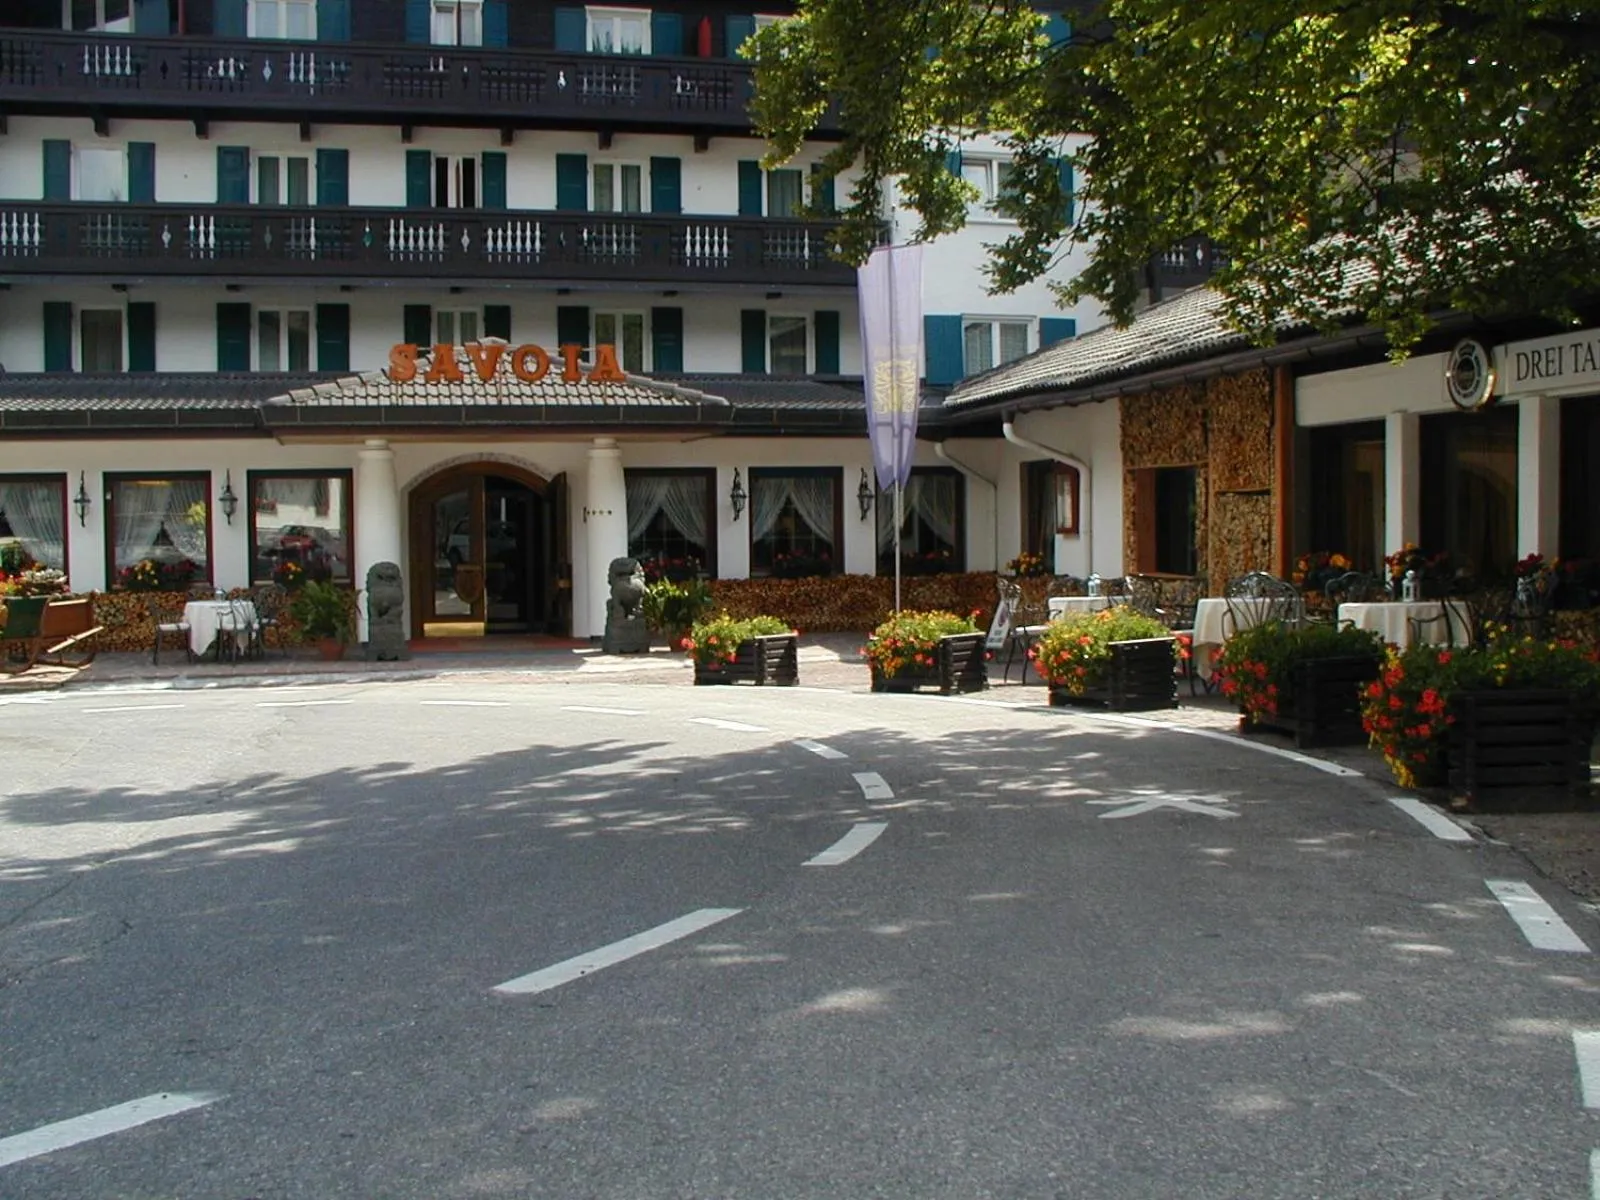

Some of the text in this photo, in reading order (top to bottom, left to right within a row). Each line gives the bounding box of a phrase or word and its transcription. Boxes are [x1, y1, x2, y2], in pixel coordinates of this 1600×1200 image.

[389, 343, 626, 383] SAVOIA
[1516, 345, 1563, 381] DREI
[1570, 339, 1600, 373] TA
